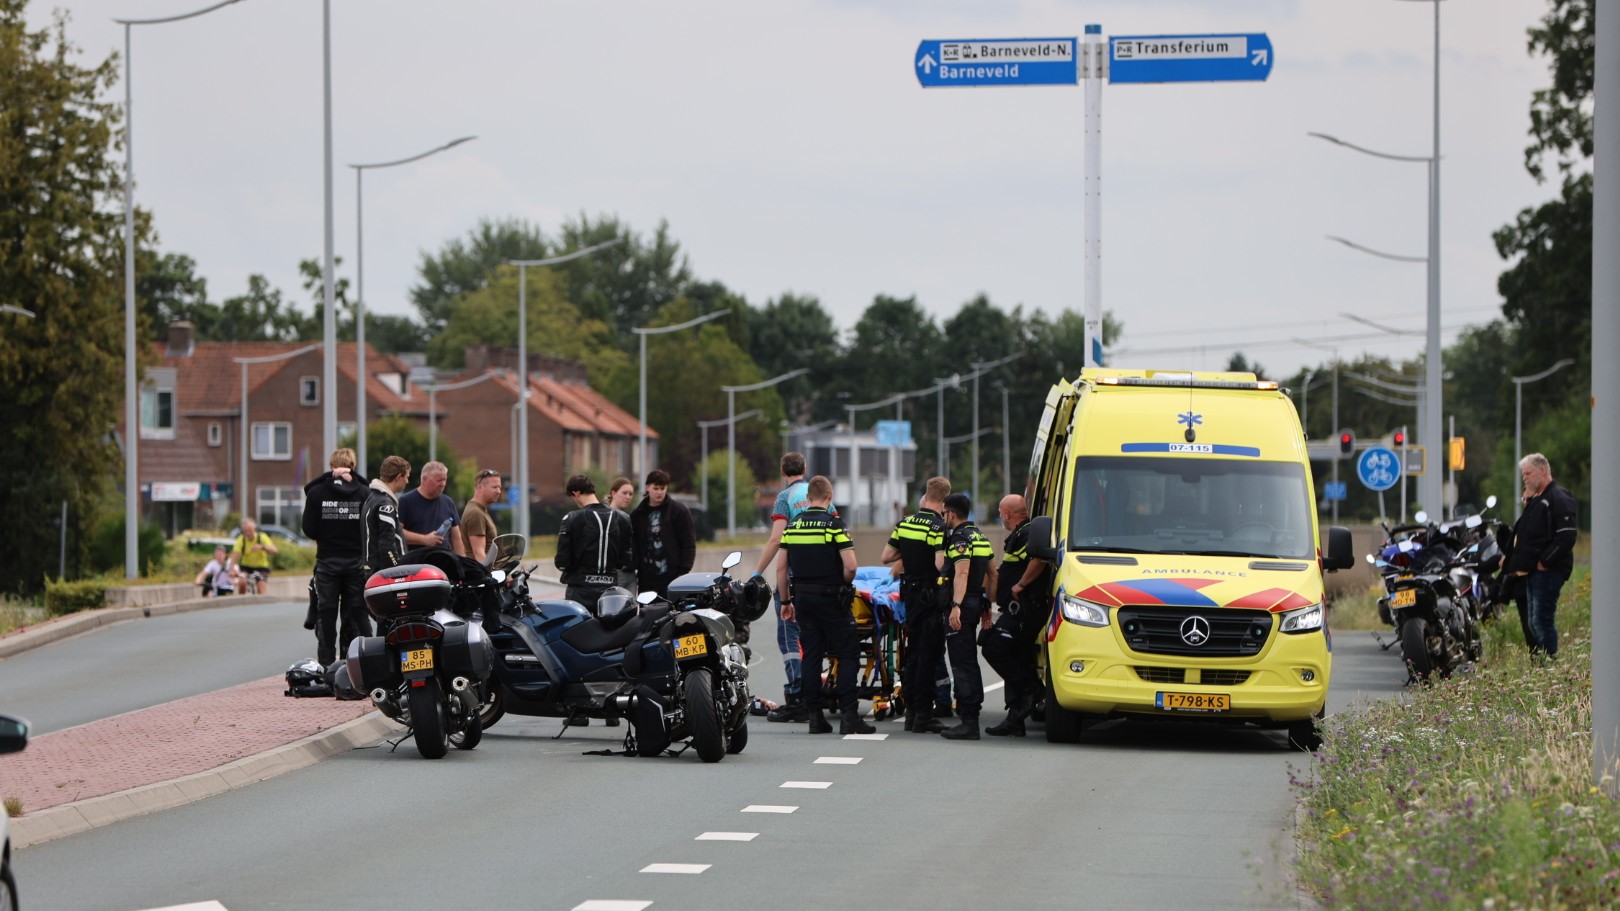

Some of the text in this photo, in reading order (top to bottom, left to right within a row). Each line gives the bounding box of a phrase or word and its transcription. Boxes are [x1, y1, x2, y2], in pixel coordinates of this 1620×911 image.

[981, 44, 1071, 57] Barneveld-N.
[1135, 40, 1229, 54] Transferium
[939, 64, 1019, 79] Barneveld
[1170, 444, 1210, 452] 07-115
[321, 500, 339, 508] RIDE
[1142, 569, 1247, 577] AMBULANCE
[685, 636, 698, 646] 60
[412, 651, 425, 660] 85
[675, 644, 705, 657] MB-KP
[402, 660, 432, 671] MS-PH
[1167, 694, 1224, 708] T-798-KS
